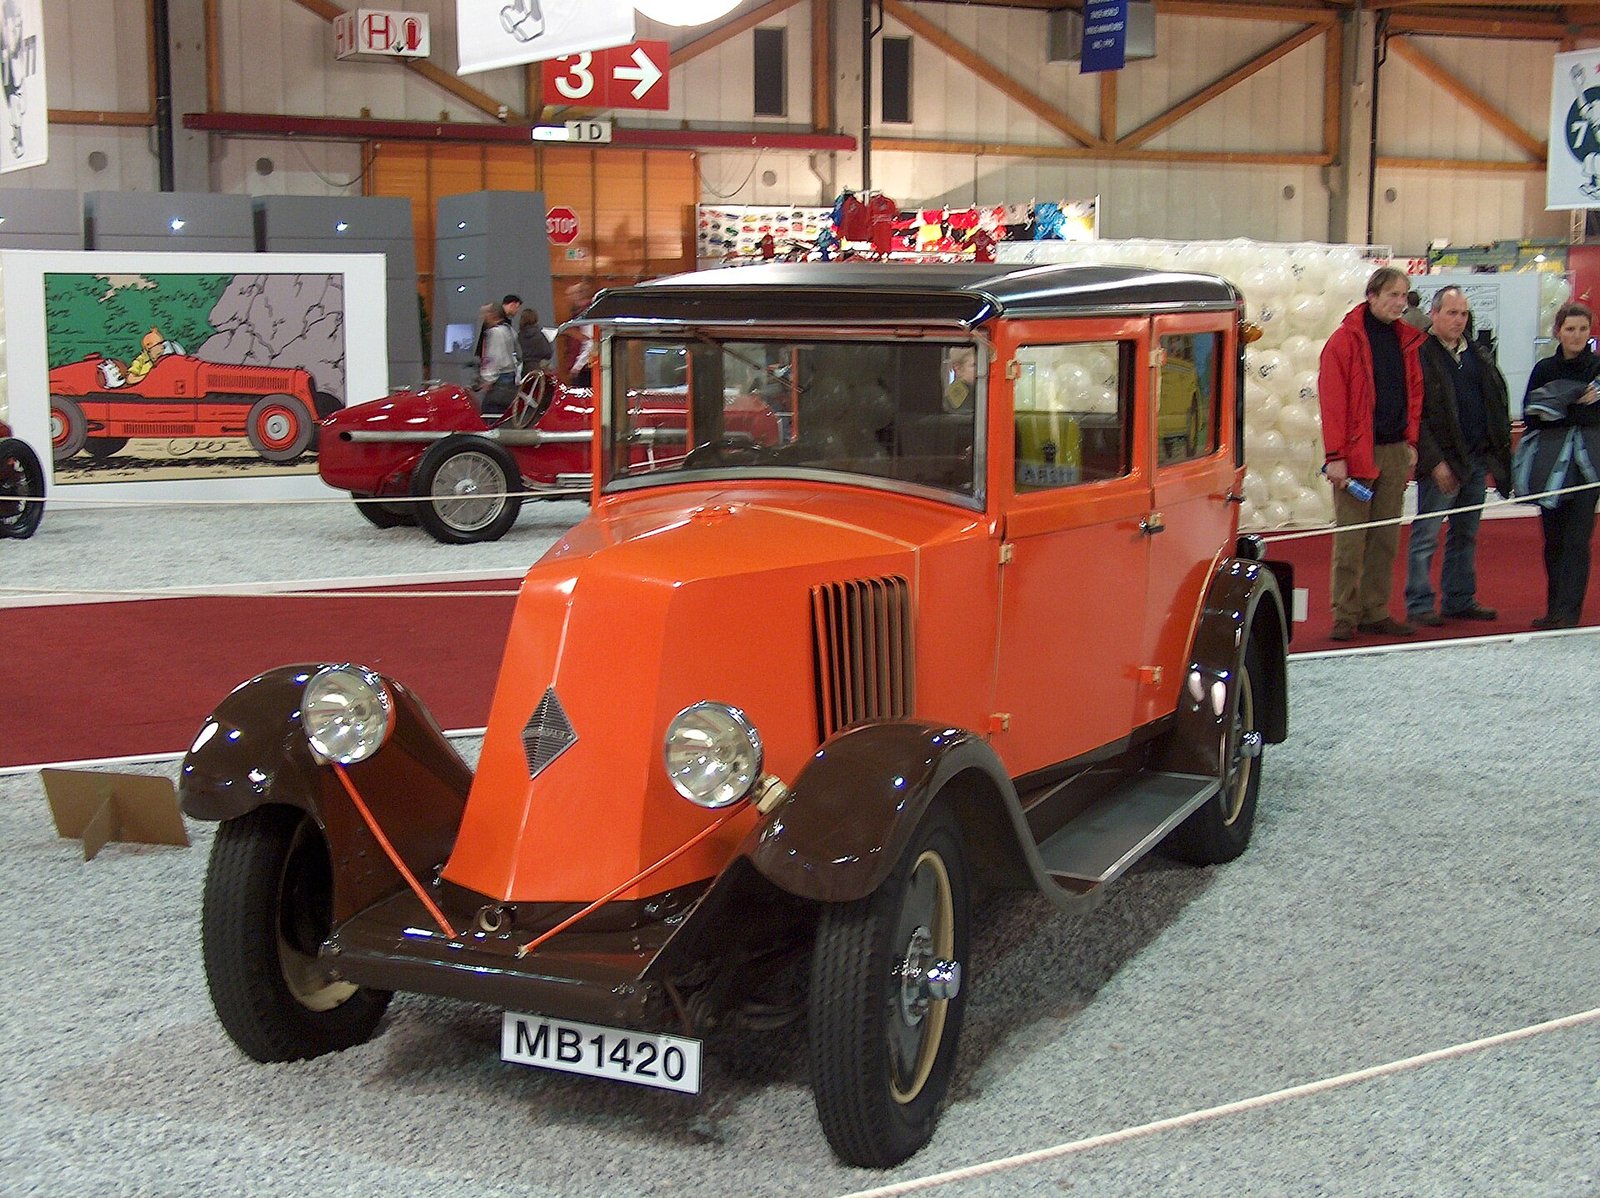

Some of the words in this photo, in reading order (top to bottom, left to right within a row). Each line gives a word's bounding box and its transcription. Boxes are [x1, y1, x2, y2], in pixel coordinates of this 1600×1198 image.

[367, 14, 390, 50] H
[554, 50, 595, 99] 3
[545, 216, 578, 234] STOP
[515, 1020, 686, 1083] MB1420
